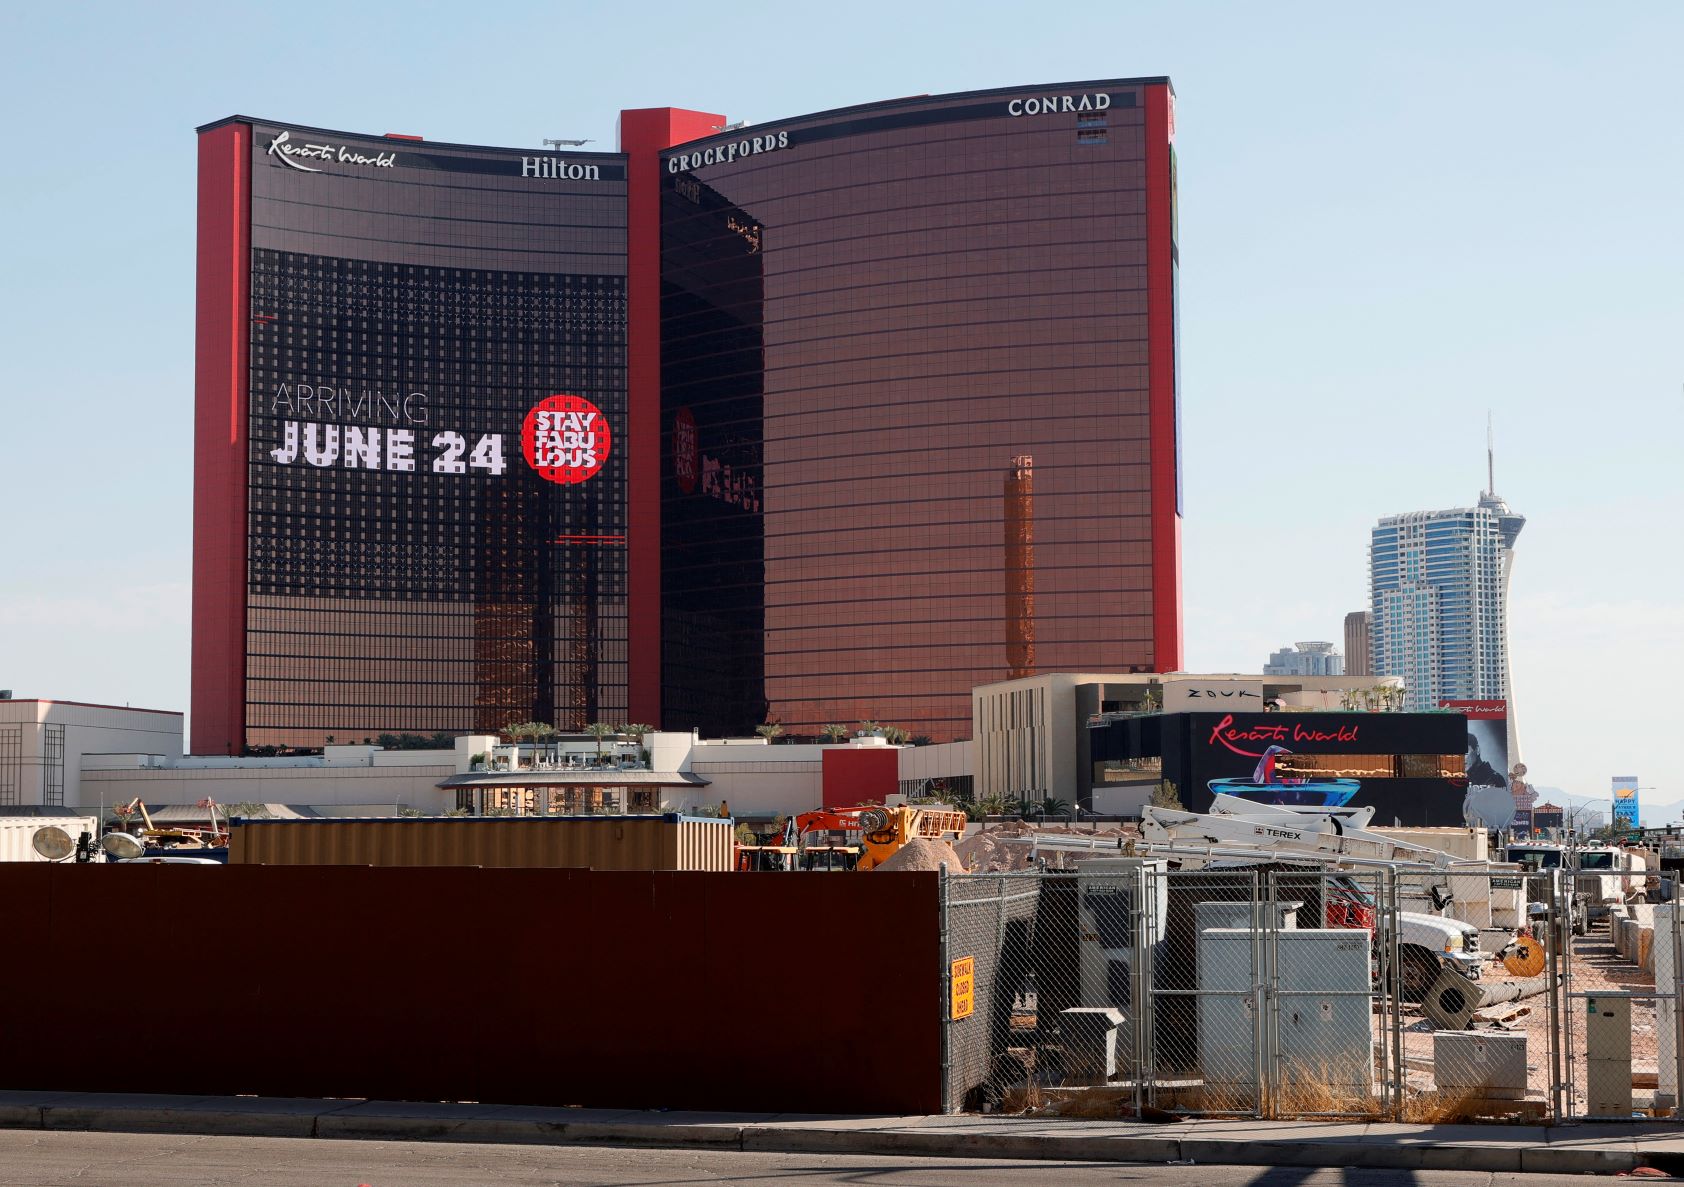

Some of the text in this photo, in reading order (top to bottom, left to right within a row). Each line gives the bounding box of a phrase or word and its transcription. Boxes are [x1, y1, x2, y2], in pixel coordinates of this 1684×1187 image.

[1008, 93, 1111, 116] CONRAD
[268, 130, 396, 172] Resorts World
[668, 131, 788, 173] CROCKFORDS
[521, 156, 600, 181] Hilton
[271, 382, 429, 423] ARRIVING
[535, 410, 597, 432] STAY
[270, 420, 507, 476] JUNE 24
[535, 430, 595, 450] FABU
[535, 448, 597, 468] LOUS
[1188, 688, 1261, 698] ZOUK
[1475, 705, 1506, 713] World
[1209, 714, 1359, 757] Resorts World
[1266, 828, 1301, 840] TEREX
[957, 999, 968, 1013] AHEAD
